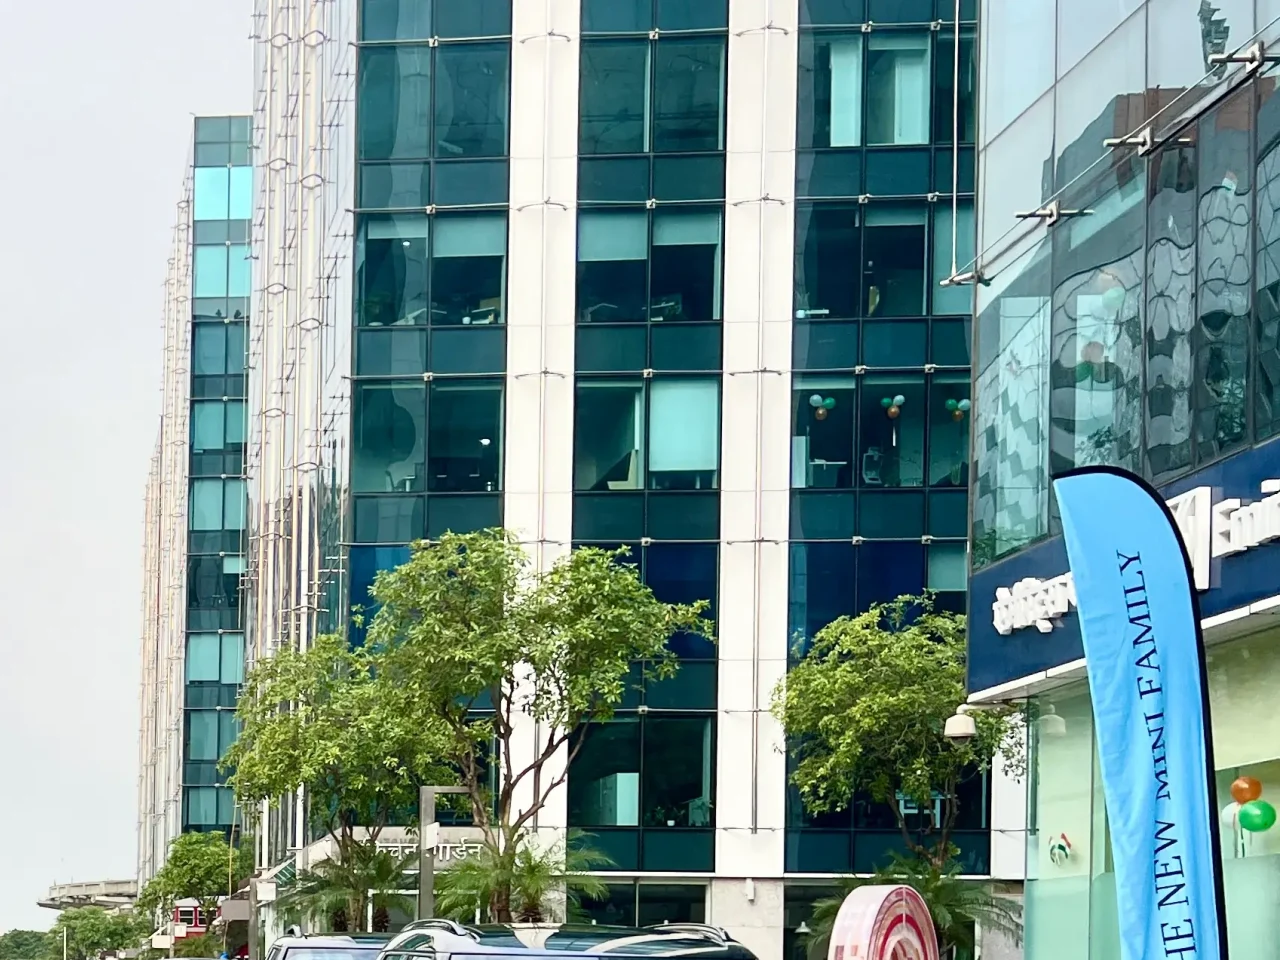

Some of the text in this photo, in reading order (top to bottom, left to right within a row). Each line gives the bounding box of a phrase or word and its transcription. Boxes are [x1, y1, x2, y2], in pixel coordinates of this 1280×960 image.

[1116, 549, 1163, 699] FAMILY
[1144, 708, 1171, 800] MINI
[1153, 819, 1189, 910] NEW
